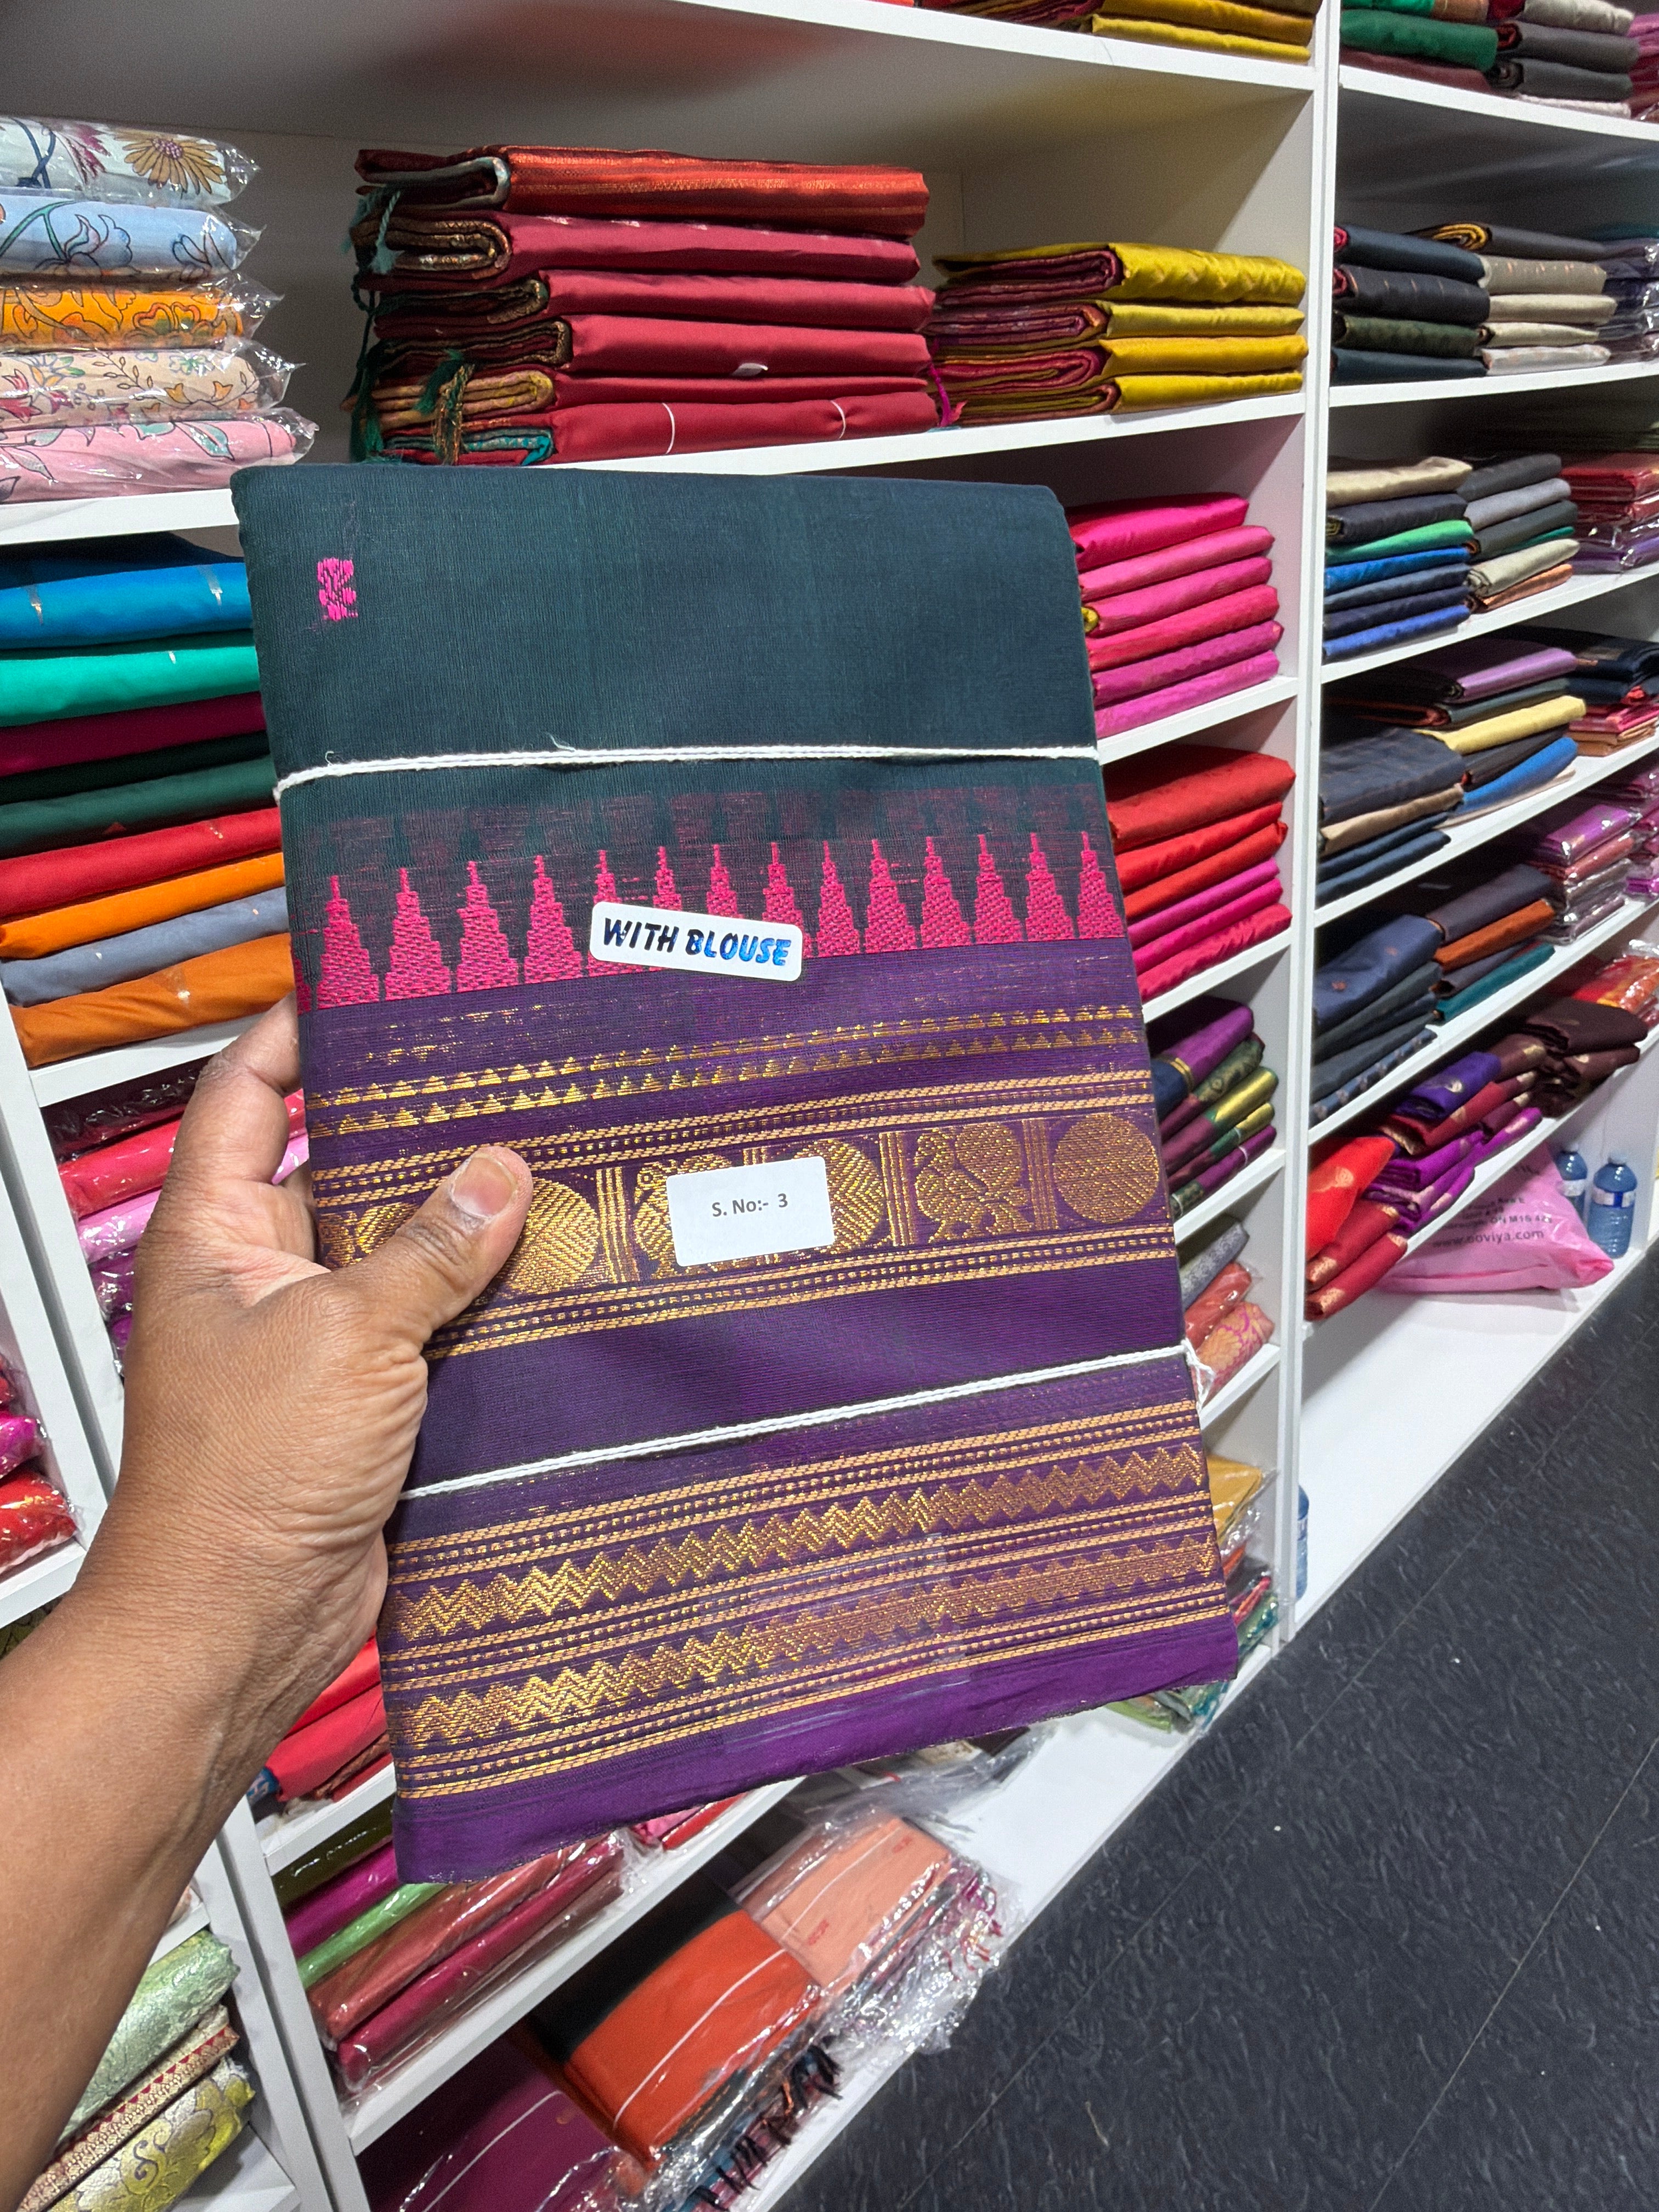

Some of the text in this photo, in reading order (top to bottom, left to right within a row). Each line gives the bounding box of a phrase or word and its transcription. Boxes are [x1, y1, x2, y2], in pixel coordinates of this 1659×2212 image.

[603, 917, 792, 966] WITH BLOUSE
[712, 1193, 789, 1217] S. No:- 3
